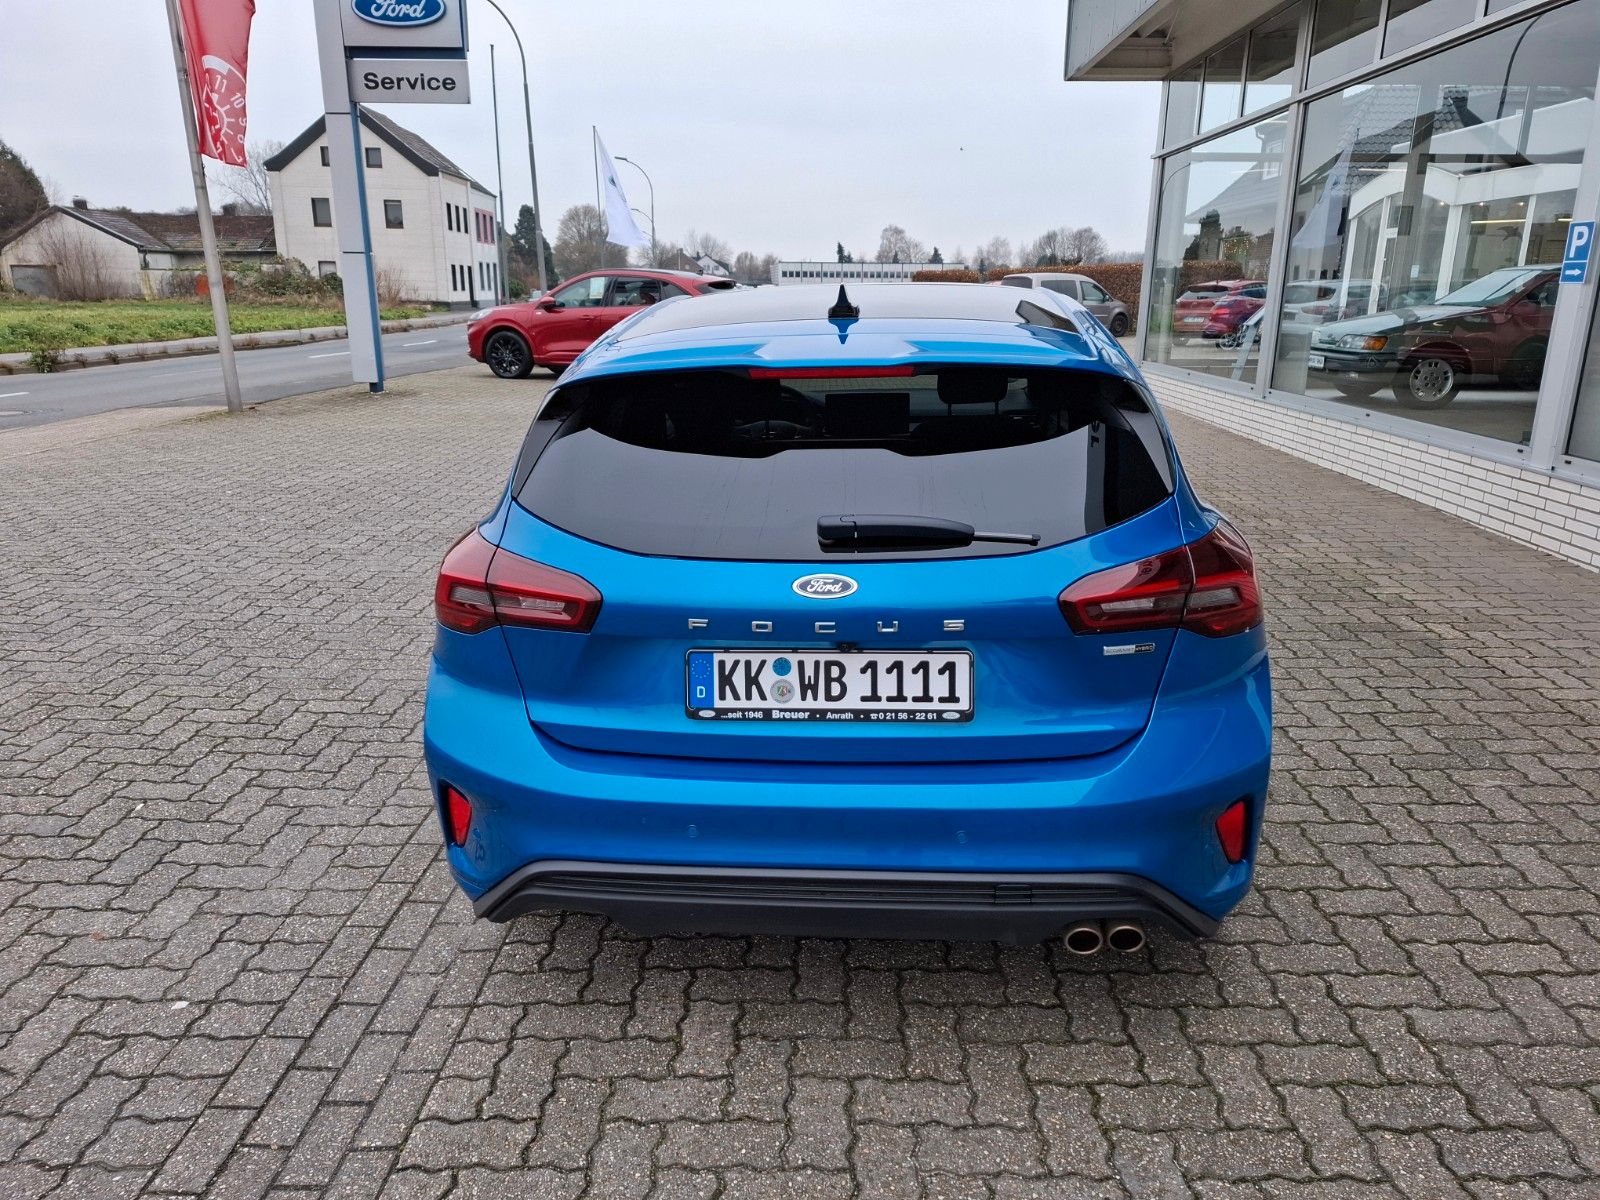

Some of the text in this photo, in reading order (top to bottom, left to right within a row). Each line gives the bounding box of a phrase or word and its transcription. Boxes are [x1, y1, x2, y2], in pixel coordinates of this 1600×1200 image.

[370, 0, 425, 17] Ford
[363, 72, 456, 91] Service
[1569, 225, 1589, 258] P
[806, 578, 843, 593] Ford
[688, 618, 965, 633] FOCUS
[718, 659, 960, 704] KK WB 1111
[696, 686, 706, 698] D
[744, 711, 764, 719] 1946
[771, 709, 810, 719] Breuer
[826, 711, 854, 719] Anrath
[885, 712, 896, 720] 21
[915, 712, 926, 720] 22
[927, 712, 938, 720] 61
